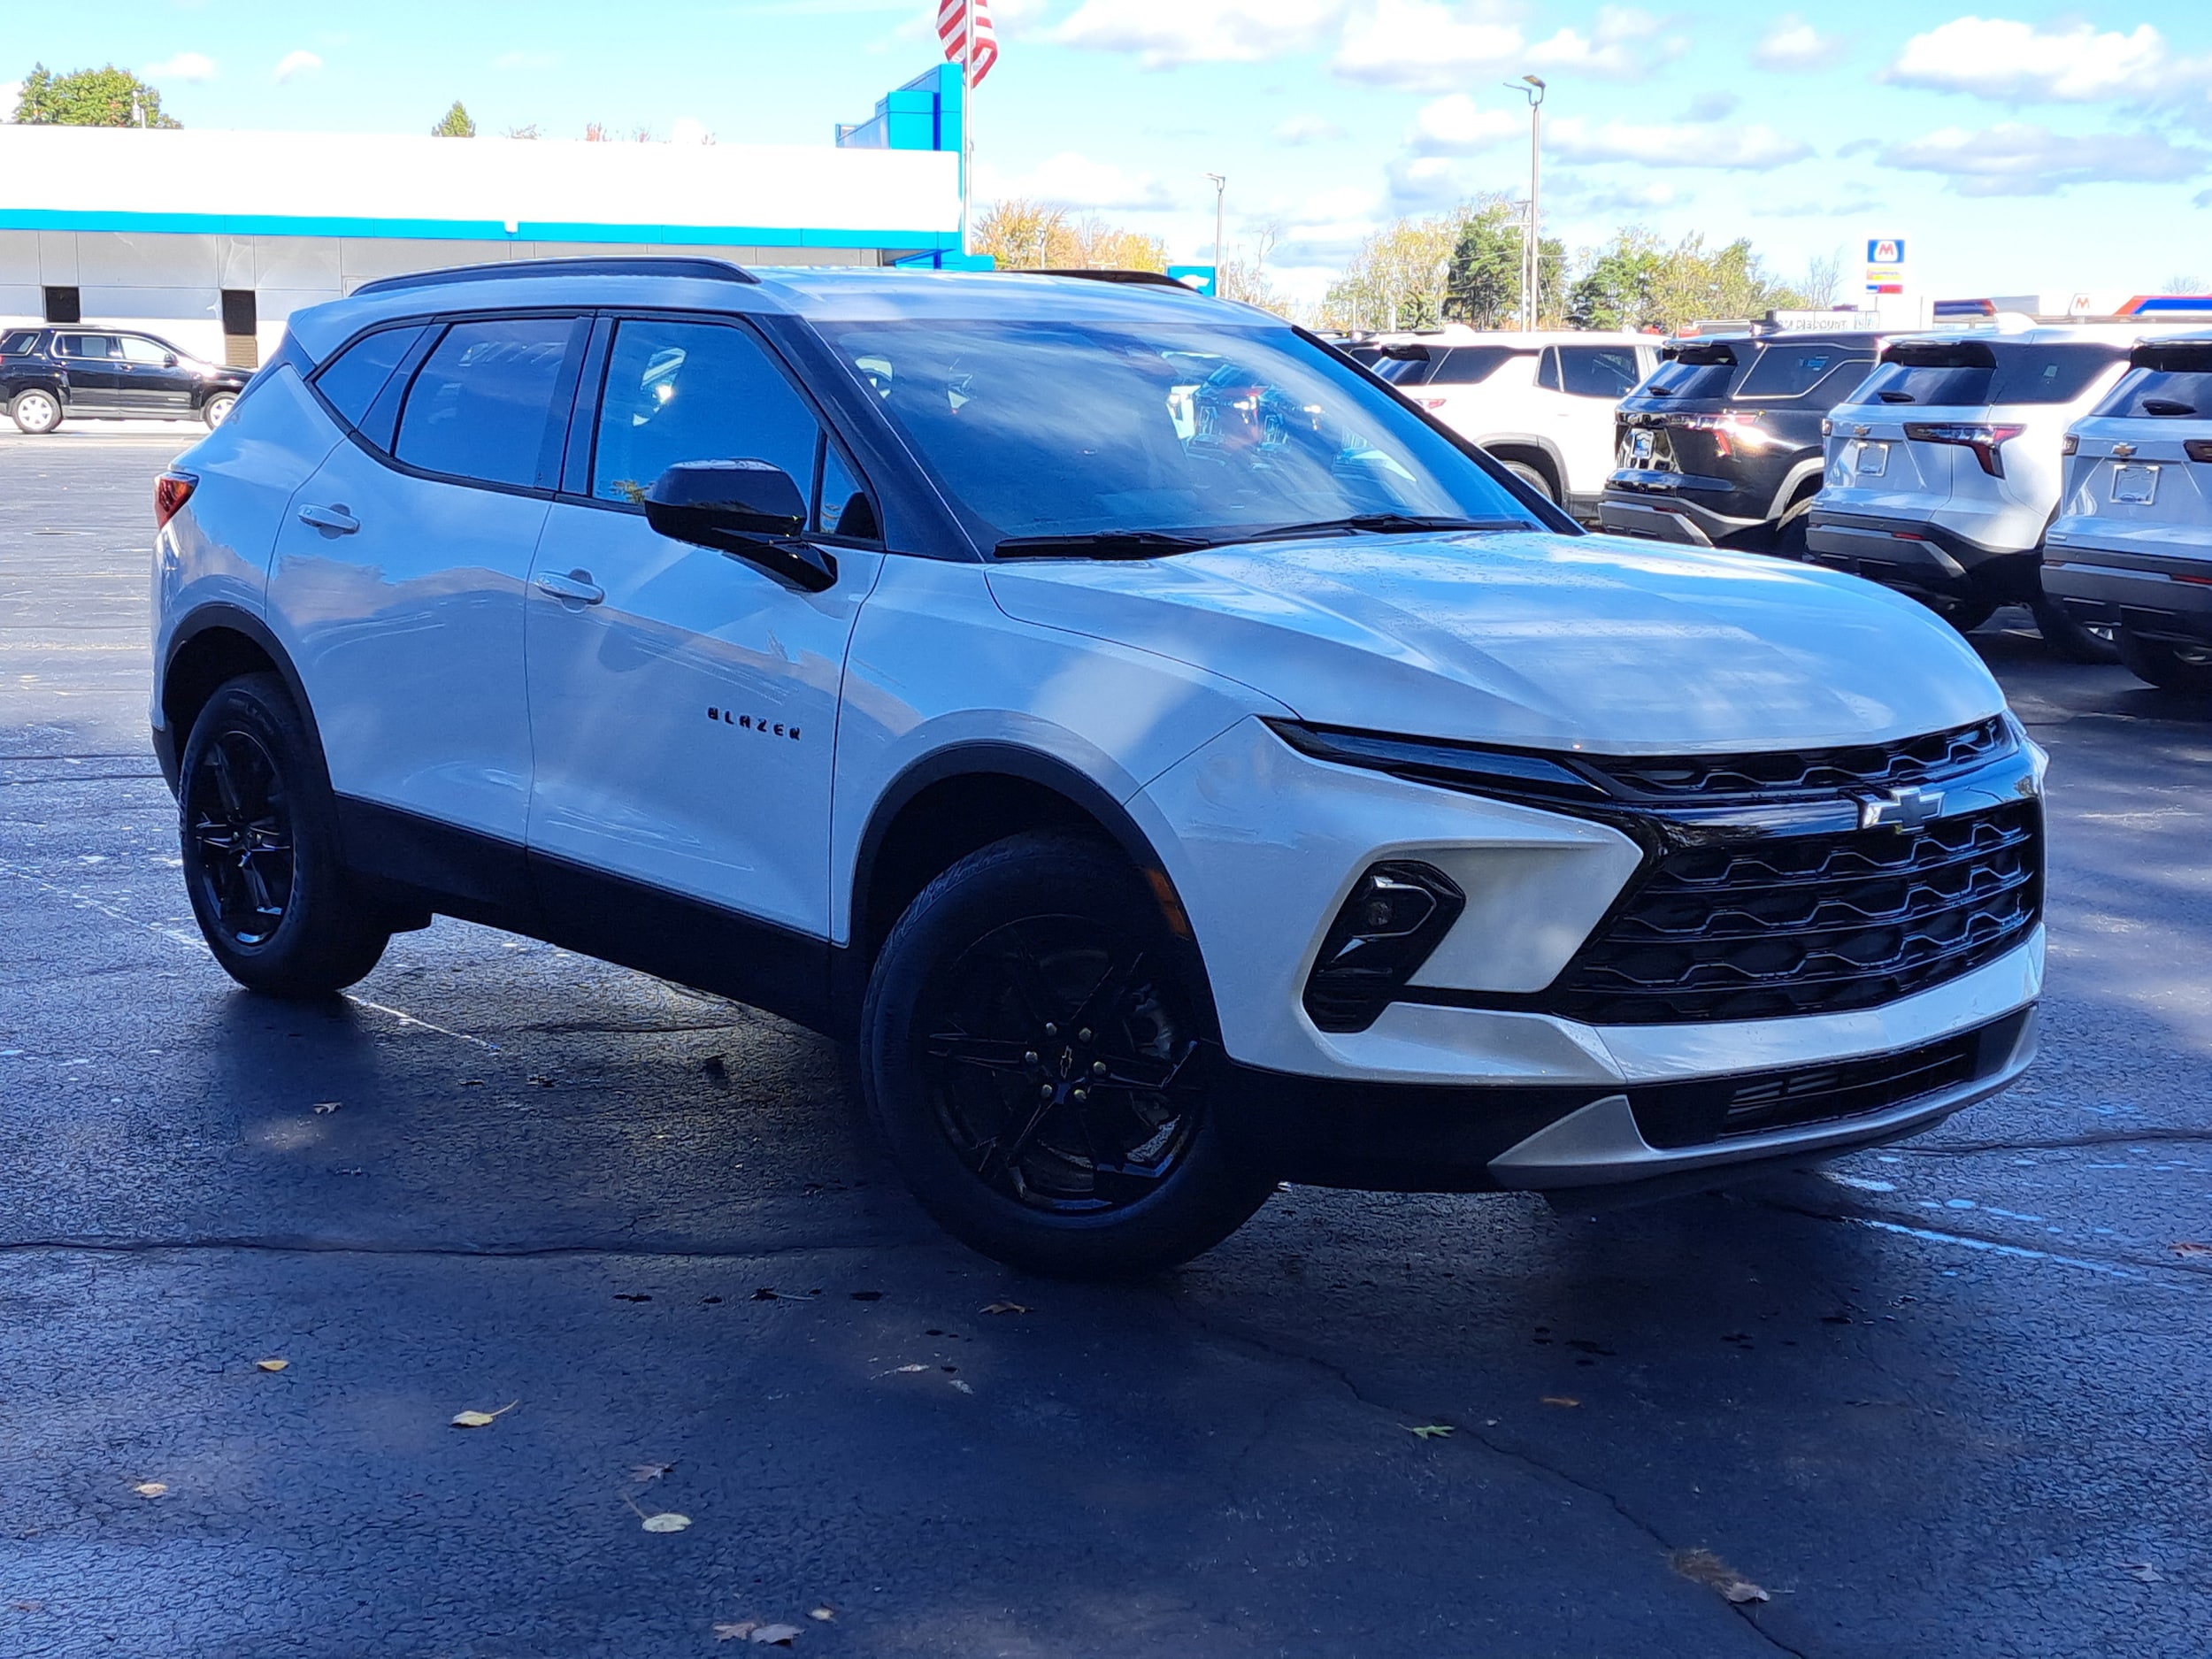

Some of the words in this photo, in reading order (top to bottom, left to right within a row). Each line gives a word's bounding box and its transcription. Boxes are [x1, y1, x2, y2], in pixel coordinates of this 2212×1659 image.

[1878, 242, 1894, 256] M
[2076, 297, 2090, 309] M
[1796, 319, 1848, 330] DISCOUNT
[707, 706, 801, 741] BLAZER
